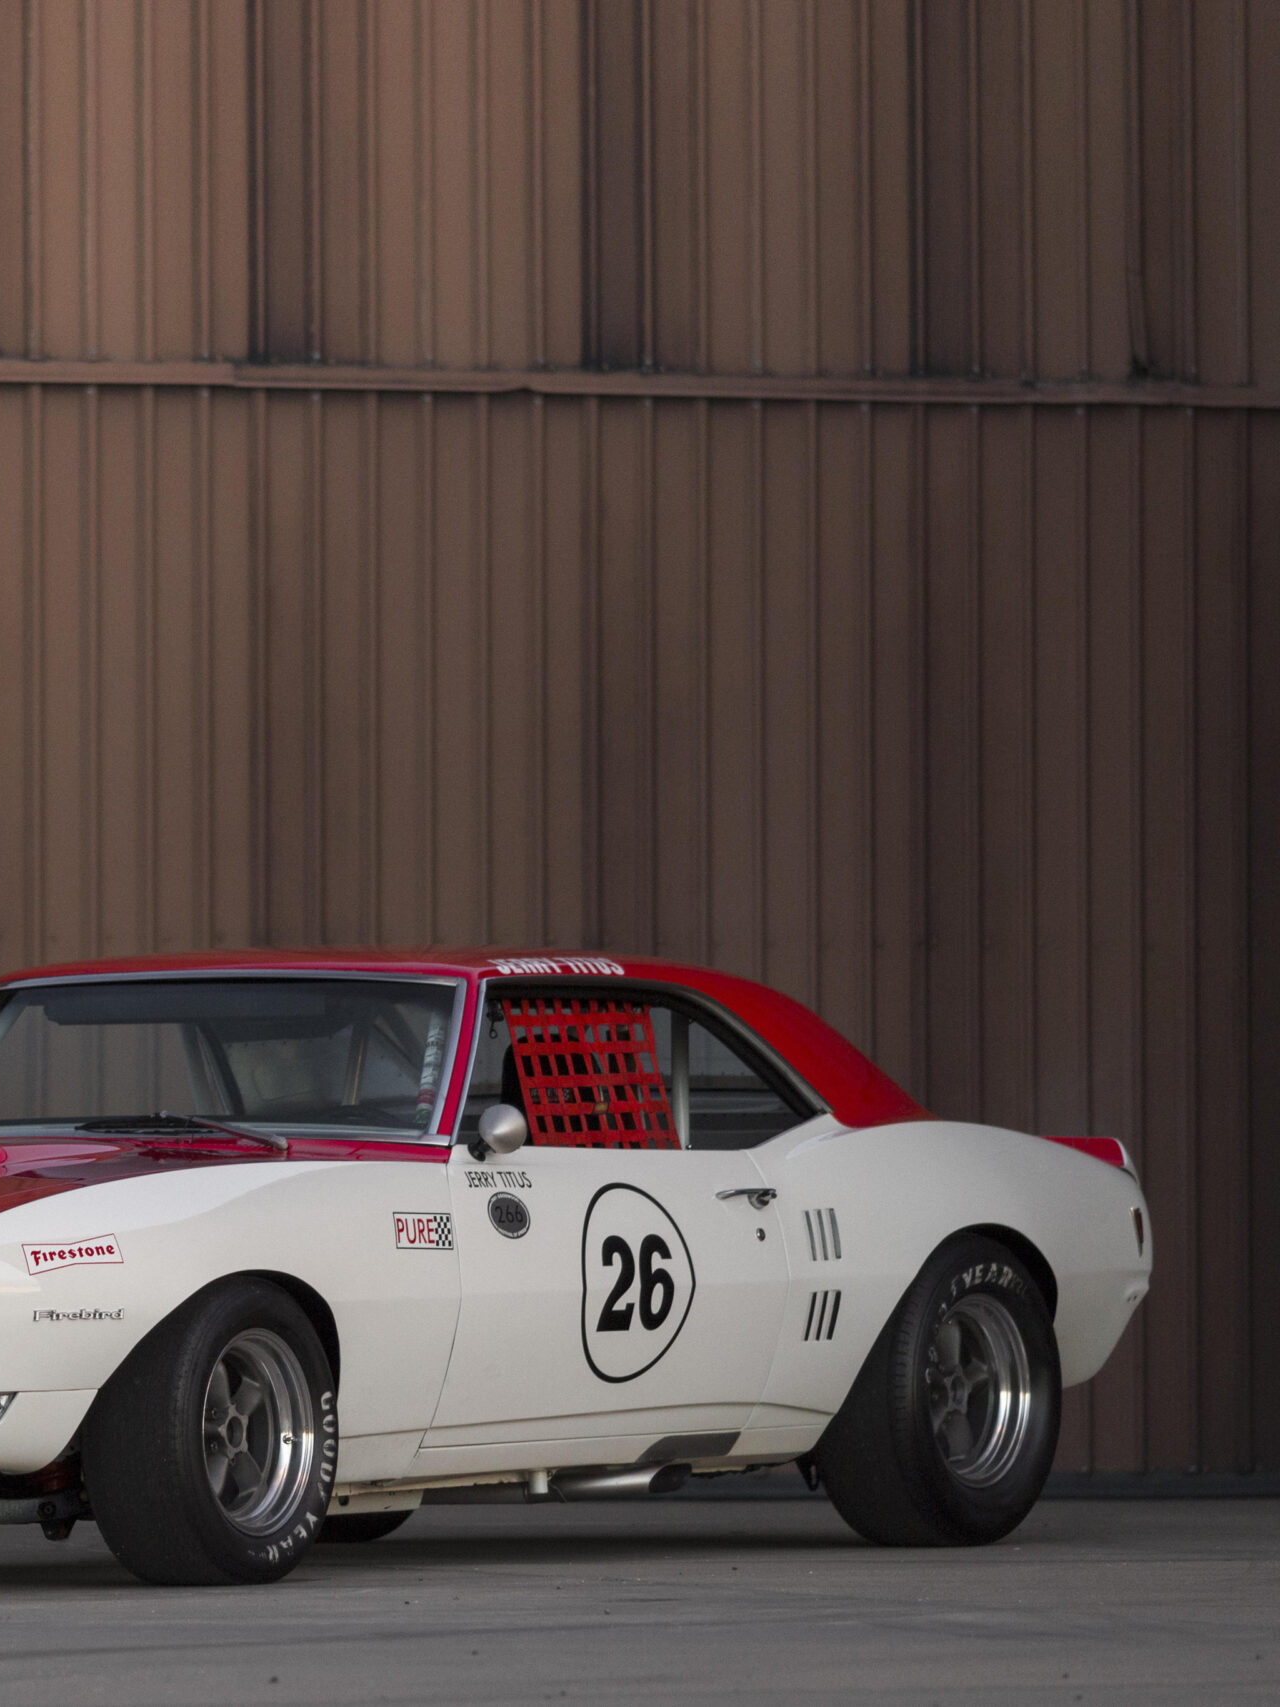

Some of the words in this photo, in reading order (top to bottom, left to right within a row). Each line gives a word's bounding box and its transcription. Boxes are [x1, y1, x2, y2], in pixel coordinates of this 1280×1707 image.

[464, 1171, 498, 1189] JERRY
[496, 1171, 533, 1189] TITUS
[494, 1204, 524, 1224] 266
[396, 1217, 436, 1245] PURE
[30, 1244, 116, 1267] Firestone
[596, 1233, 675, 1332] 26
[32, 1308, 125, 1322] Firebird
